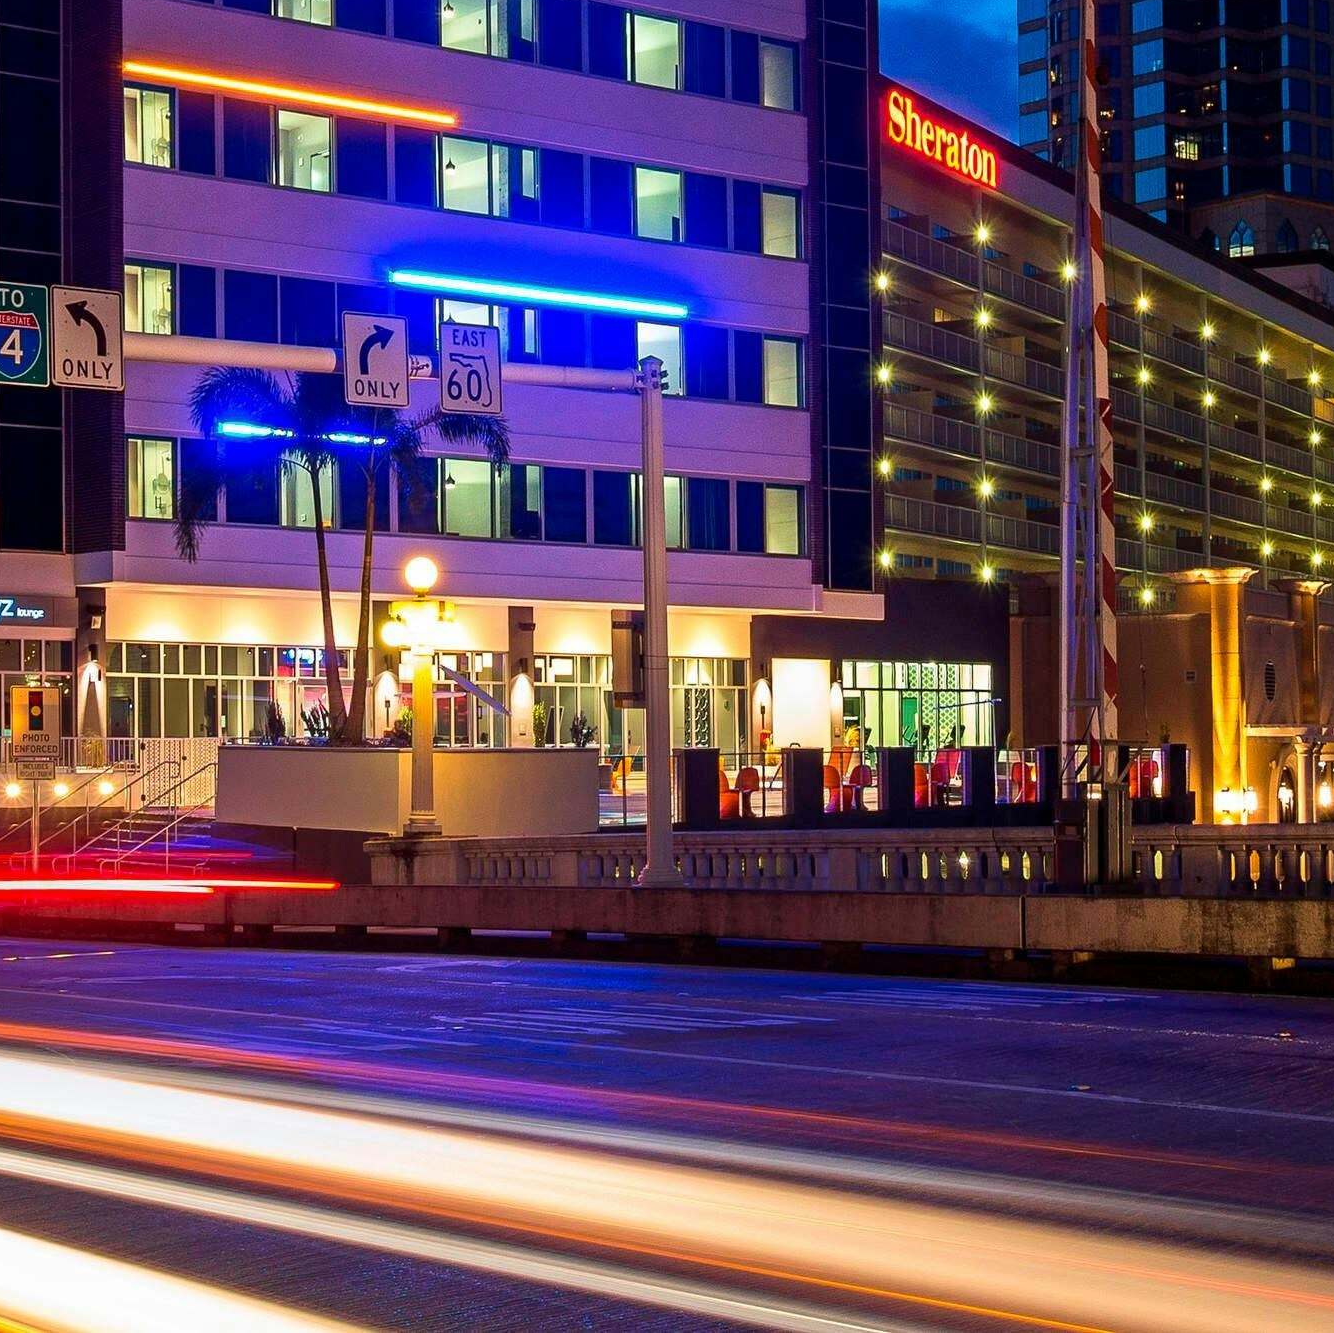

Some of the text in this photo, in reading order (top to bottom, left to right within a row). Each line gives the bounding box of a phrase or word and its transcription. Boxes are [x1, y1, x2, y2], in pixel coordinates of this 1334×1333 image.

[888, 90, 997, 187] Sheraton
[0, 329, 24, 365] 4
[452, 329, 486, 347] EAST
[63, 358, 113, 380] ONLY
[354, 379, 400, 399] ONLY
[447, 369, 482, 402] 60
[16, 607, 44, 619] lounge
[22, 734, 50, 742] PHOTO
[14, 745, 58, 753] ENFORCED
